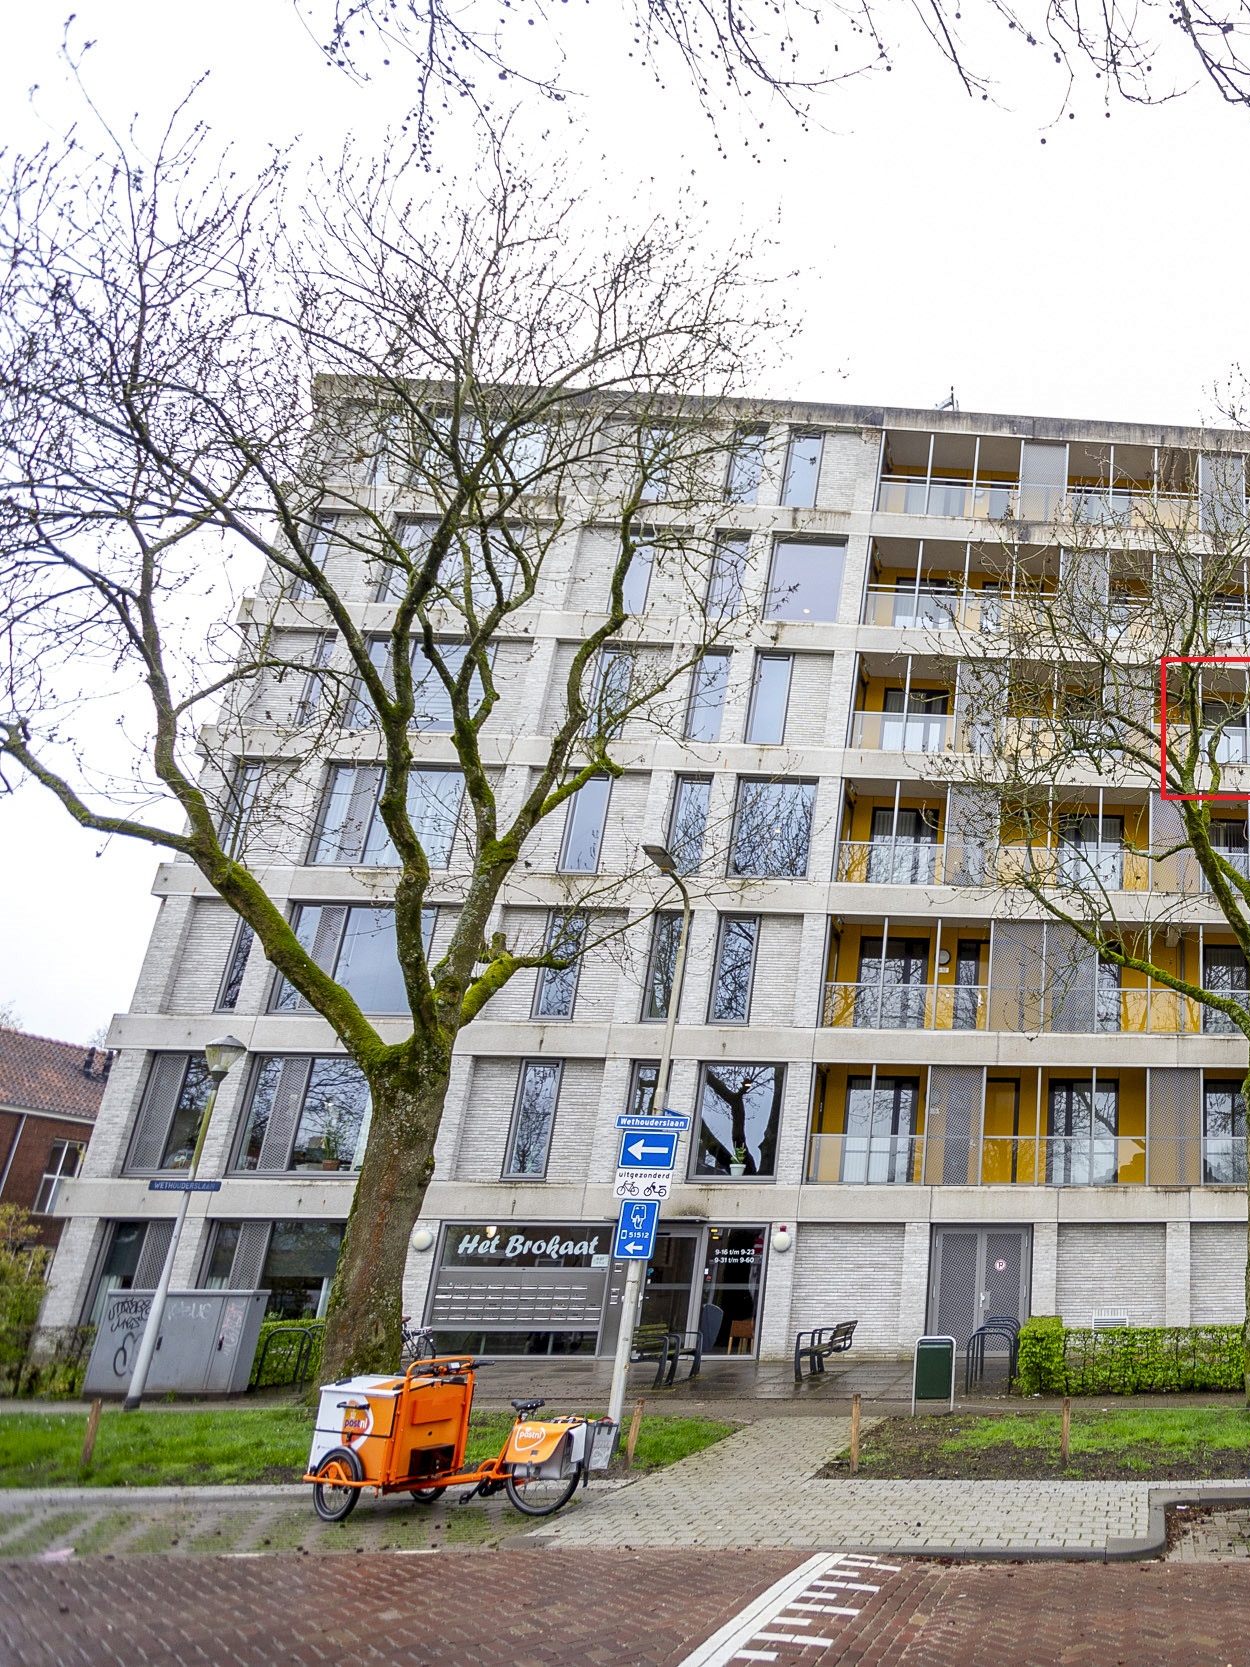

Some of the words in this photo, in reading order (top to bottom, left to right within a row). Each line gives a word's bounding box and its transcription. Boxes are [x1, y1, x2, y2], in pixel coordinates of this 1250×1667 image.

[620, 1118, 685, 1127] Wethouderslaan
[618, 1171, 670, 1179] uitgezonderd
[154, 1181, 215, 1190] WETHOUDERSLAAN
[628, 1231, 650, 1239] 51512
[457, 1234, 501, 1254] Het
[505, 1234, 599, 1259] Brokaat
[344, 1418, 368, 1429] postnl
